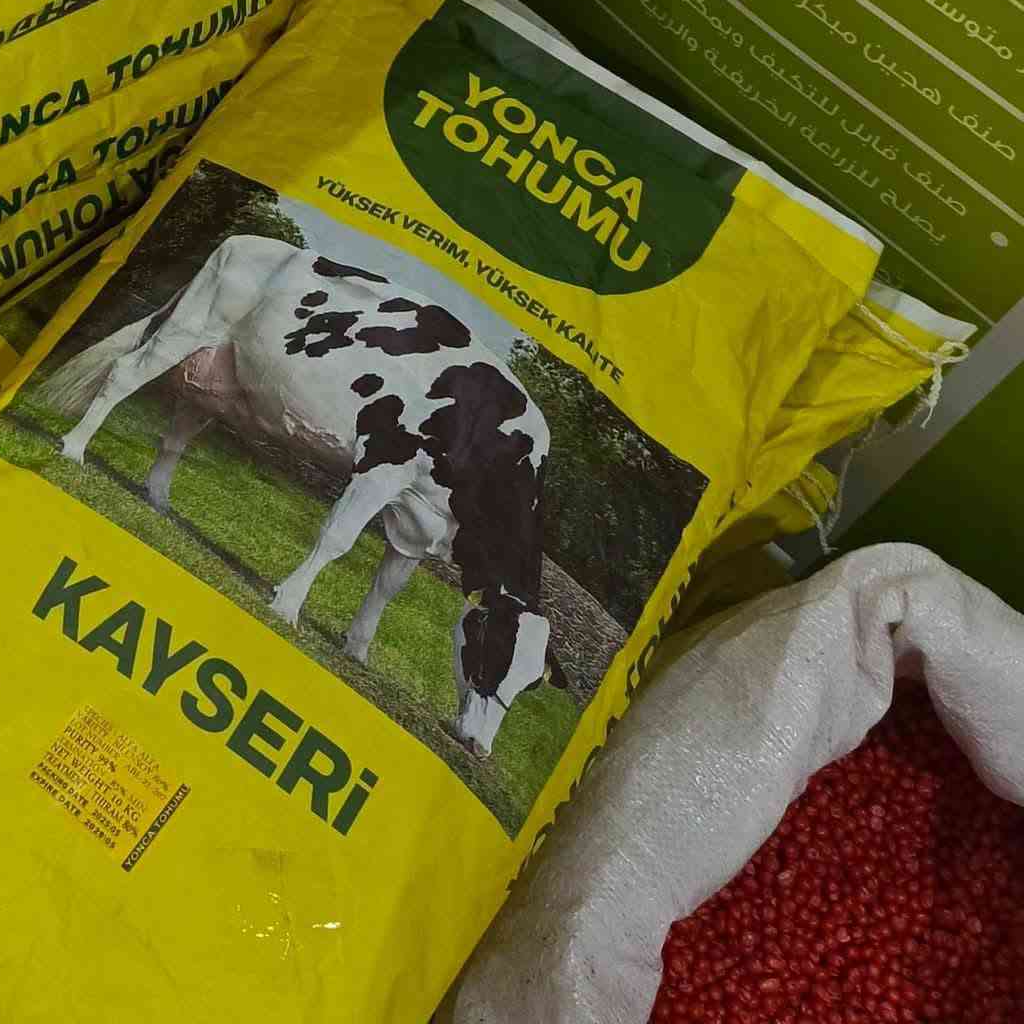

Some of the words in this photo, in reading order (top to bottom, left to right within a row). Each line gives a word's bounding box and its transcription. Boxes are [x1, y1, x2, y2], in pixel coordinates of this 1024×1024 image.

[704, 46, 797, 129] الخريفية
[750, 44, 840, 117] للتكيف
[863, 42, 942, 106] هجين
[465, 72, 645, 223] YONCA
[800, 124, 880, 190] للزراعة
[840, 118, 898, 162] قابل
[948, 104, 1016, 161] صنف
[413, 90, 652, 272] TOHUMU
[903, 161, 968, 217] صنف
[879, 188, 946, 246] يصلح
[317, 176, 402, 224] YÜKSEK
[476, 258, 558, 329] YÜKSEK
[62, 723, 99, 756] PURITY
[49, 740, 71, 760] NET
[68, 756, 113, 796] WEIGHT
[109, 793, 124, 807] 10
[121, 802, 142, 822] KG
[55, 794, 82, 818] DATE
[65, 786, 89, 809] DATE
[125, 830, 157, 866] YONCA
